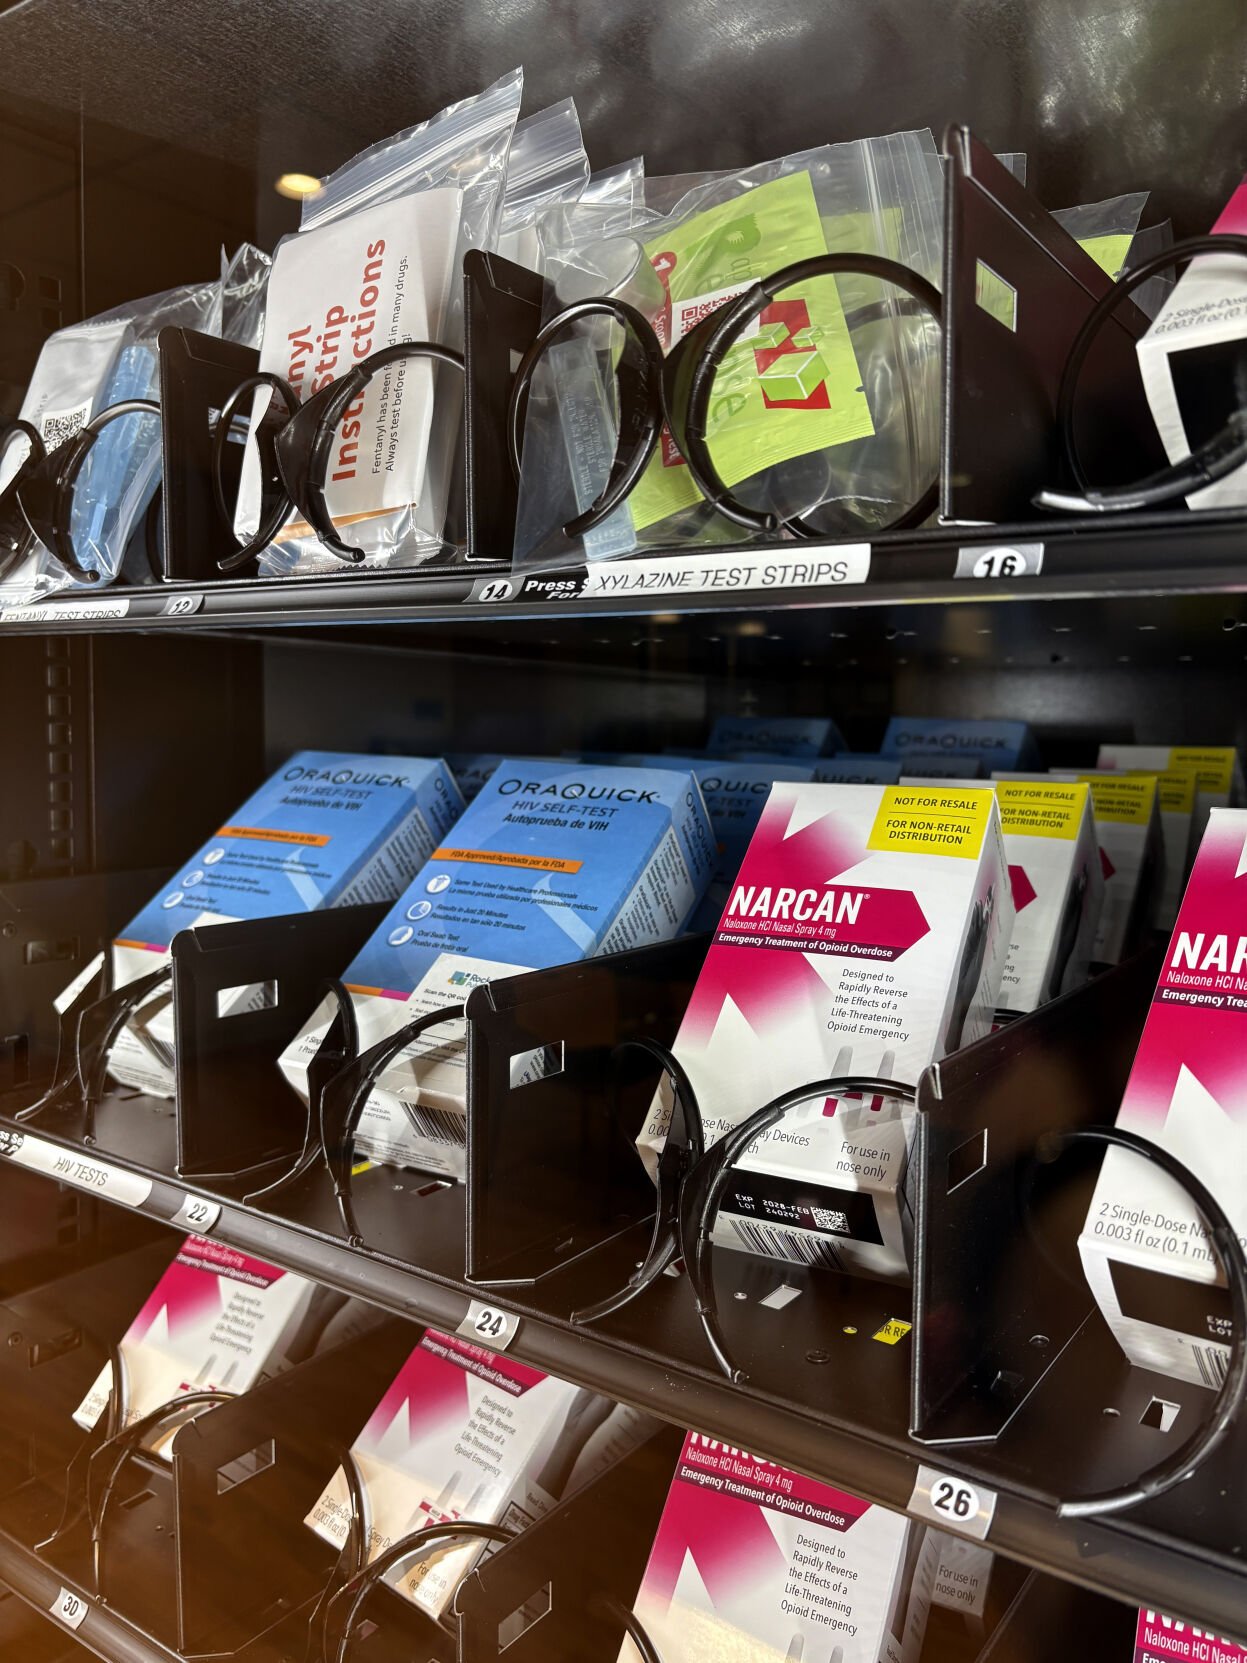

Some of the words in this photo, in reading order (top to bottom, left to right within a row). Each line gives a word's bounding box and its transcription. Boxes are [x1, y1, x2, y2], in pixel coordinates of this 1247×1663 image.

[395, 255, 409, 290] drugs.
[392, 292, 405, 323] many
[389, 325, 399, 337] in
[311, 305, 350, 396] Strip
[332, 239, 387, 481] Instctions
[380, 371, 392, 402] been
[393, 368, 407, 407] before
[377, 403, 388, 424] has
[391, 407, 401, 430] test
[372, 425, 388, 475] Fentanyl
[385, 431, 400, 473] Always
[596, 570, 694, 591] XYLAZINE
[700, 567, 755, 587] TEST
[761, 561, 848, 586] STRIPS
[982, 555, 1016, 578] 16
[484, 584, 507, 601] 14
[525, 580, 576, 593] Press
[547, 590, 577, 600] For
[172, 600, 191, 614] 12
[290, 785, 312, 794] HIV
[314, 786, 374, 800] SELF-TEST
[894, 797, 915, 806] NOT
[917, 798, 938, 808] FOR
[940, 800, 978, 811] RESALE
[1004, 789, 1022, 798] NOT
[1024, 790, 1041, 799] FOR
[1043, 791, 1076, 801] RESALE
[512, 800, 540, 812] HIV
[540, 803, 619, 818] SELF-TEST
[1018, 808, 1070, 820] NON-RETAIL
[503, 813, 568, 828] Autoprueba
[570, 819, 586, 829] de
[588, 821, 610, 832] VIH
[886, 820, 907, 829] FOR
[909, 820, 972, 835] NON-RETAIL
[888, 830, 963, 845] DISTRIBUTION
[724, 917, 757, 931] Naloxone
[758, 920, 772, 931] HCl
[772, 921, 794, 934] Nasal
[794, 923, 817, 937] Spray
[818, 926, 824, 935] 4
[824, 928, 837, 938] mg
[718, 932, 764, 946] Emergency
[764, 936, 807, 949] Treatment
[808, 939, 819, 949] of
[819, 941, 848, 954] Opioid
[850, 945, 893, 958] Overdose
[842, 968, 884, 983] Designed
[885, 974, 895, 983] to
[1166, 970, 1213, 987] Naloxone
[1215, 975, 1233, 989] HCl
[838, 981, 871, 996] Rapidly
[873, 986, 908, 998] Reverse
[1162, 989, 1225, 1007] Emergency
[835, 995, 849, 1005] the
[851, 996, 879, 1008] Effects
[881, 1000, 892, 1010] of
[892, 1002, 898, 1010] a
[831, 1007, 903, 1026] Life-Threatening
[827, 1021, 856, 1034] Opioid
[859, 1024, 909, 1042] Emergency
[653, 1109, 661, 1119] 2
[773, 1128, 810, 1147] Devices
[841, 1142, 858, 1155] For
[859, 1145, 878, 1158] use
[880, 1148, 891, 1162] in
[54, 1156, 75, 1174] HIV
[73, 1162, 109, 1187] TESTS
[836, 1159, 861, 1175] nose
[863, 1164, 887, 1181] only
[188, 1203, 208, 1222] 22
[735, 1193, 753, 1202] EXP
[762, 1199, 810, 1215] 2028-FEB
[738, 1202, 756, 1211] LOT
[1099, 1202, 1110, 1217] 2
[1111, 1203, 1187, 1234] Single-Dose
[1094, 1221, 1132, 1242] 0.003
[1134, 1230, 1144, 1244] fl
[1145, 1236, 1162, 1249] oz
[1162, 1235, 1190, 1256] (0.1
[476, 1310, 503, 1336] 24
[481, 1395, 507, 1415] Designed
[506, 1408, 513, 1418] to
[468, 1419, 478, 1430] the
[477, 1423, 495, 1439] Effects
[475, 1406, 495, 1425] Rapidly
[495, 1417, 516, 1435] Reverse
[461, 1430, 503, 1463] Life-Threatening
[454, 1442, 473, 1460] Opioid
[472, 1453, 502, 1478] Emergency
[686, 1447, 718, 1469] Naloxone
[718, 1457, 731, 1472] HCl
[732, 1462, 753, 1478] Nasal
[753, 1466, 775, 1485] Spray
[775, 1473, 781, 1484] 4
[781, 1478, 793, 1493] mg
[680, 1465, 724, 1490] Emergency
[724, 1478, 765, 1500] Treatment
[766, 1492, 775, 1503] of
[775, 1494, 804, 1513] Opioid
[805, 1504, 845, 1526] Overdose
[934, 1481, 972, 1517] 26
[796, 1534, 835, 1556] Designed
[837, 1547, 846, 1559] to
[792, 1550, 824, 1571] Rapidly
[825, 1560, 858, 1581] Reverse
[939, 1564, 953, 1579] For
[954, 1571, 970, 1585] use
[970, 1576, 978, 1588] in
[789, 1566, 802, 1580] the
[804, 1571, 830, 1589] Effects
[832, 1580, 842, 1593] of
[842, 1586, 848, 1595] a
[784, 1582, 852, 1617] Life-Threatening
[936, 1583, 956, 1598] nose
[957, 1587, 976, 1606] only
[781, 1599, 809, 1618] Opioid
[810, 1608, 858, 1637] Emergency
[1144, 1627, 1190, 1656] Naloxone
